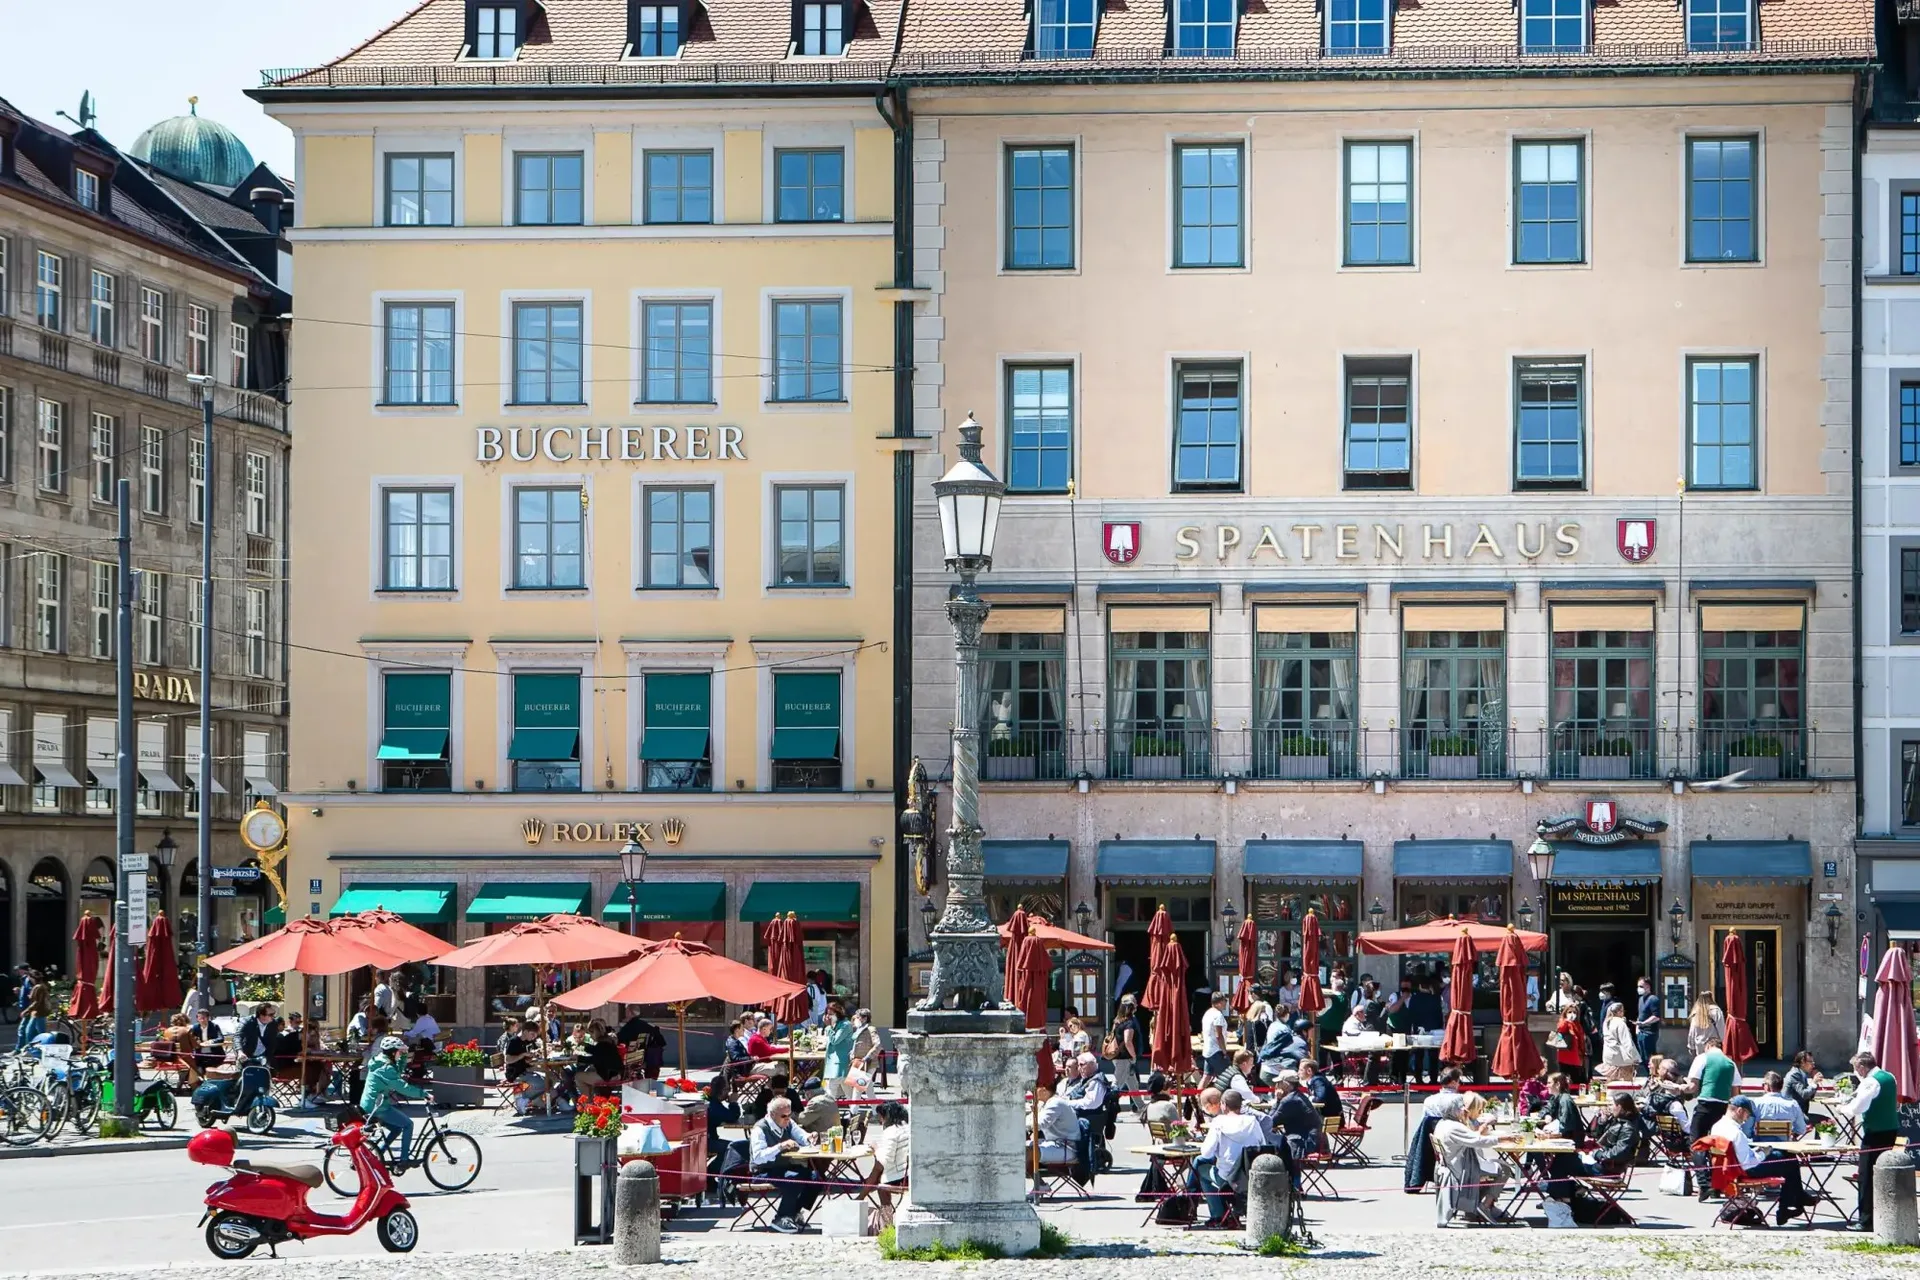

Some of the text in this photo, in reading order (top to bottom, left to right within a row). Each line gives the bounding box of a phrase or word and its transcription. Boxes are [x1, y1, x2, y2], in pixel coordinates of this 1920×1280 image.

[476, 426, 748, 461] BUCHERER
[1175, 521, 1581, 560] SPATENHAUS
[133, 672, 195, 703] RADA
[395, 703, 441, 712] BUCHERER
[524, 703, 570, 711] BUCHERER
[655, 703, 701, 711] BUCHERER
[784, 702, 831, 711] BUCHERER
[140, 750, 160, 759] PRADA
[1625, 820, 1656, 833] RESTAURANT
[551, 822, 654, 842] ROLEX
[1576, 831, 1625, 843] SPATENHAUS
[1826, 862, 1835, 870] 12
[88, 875, 109, 883] PRADA
[1558, 892, 1640, 901] IM SPATENHAUS
